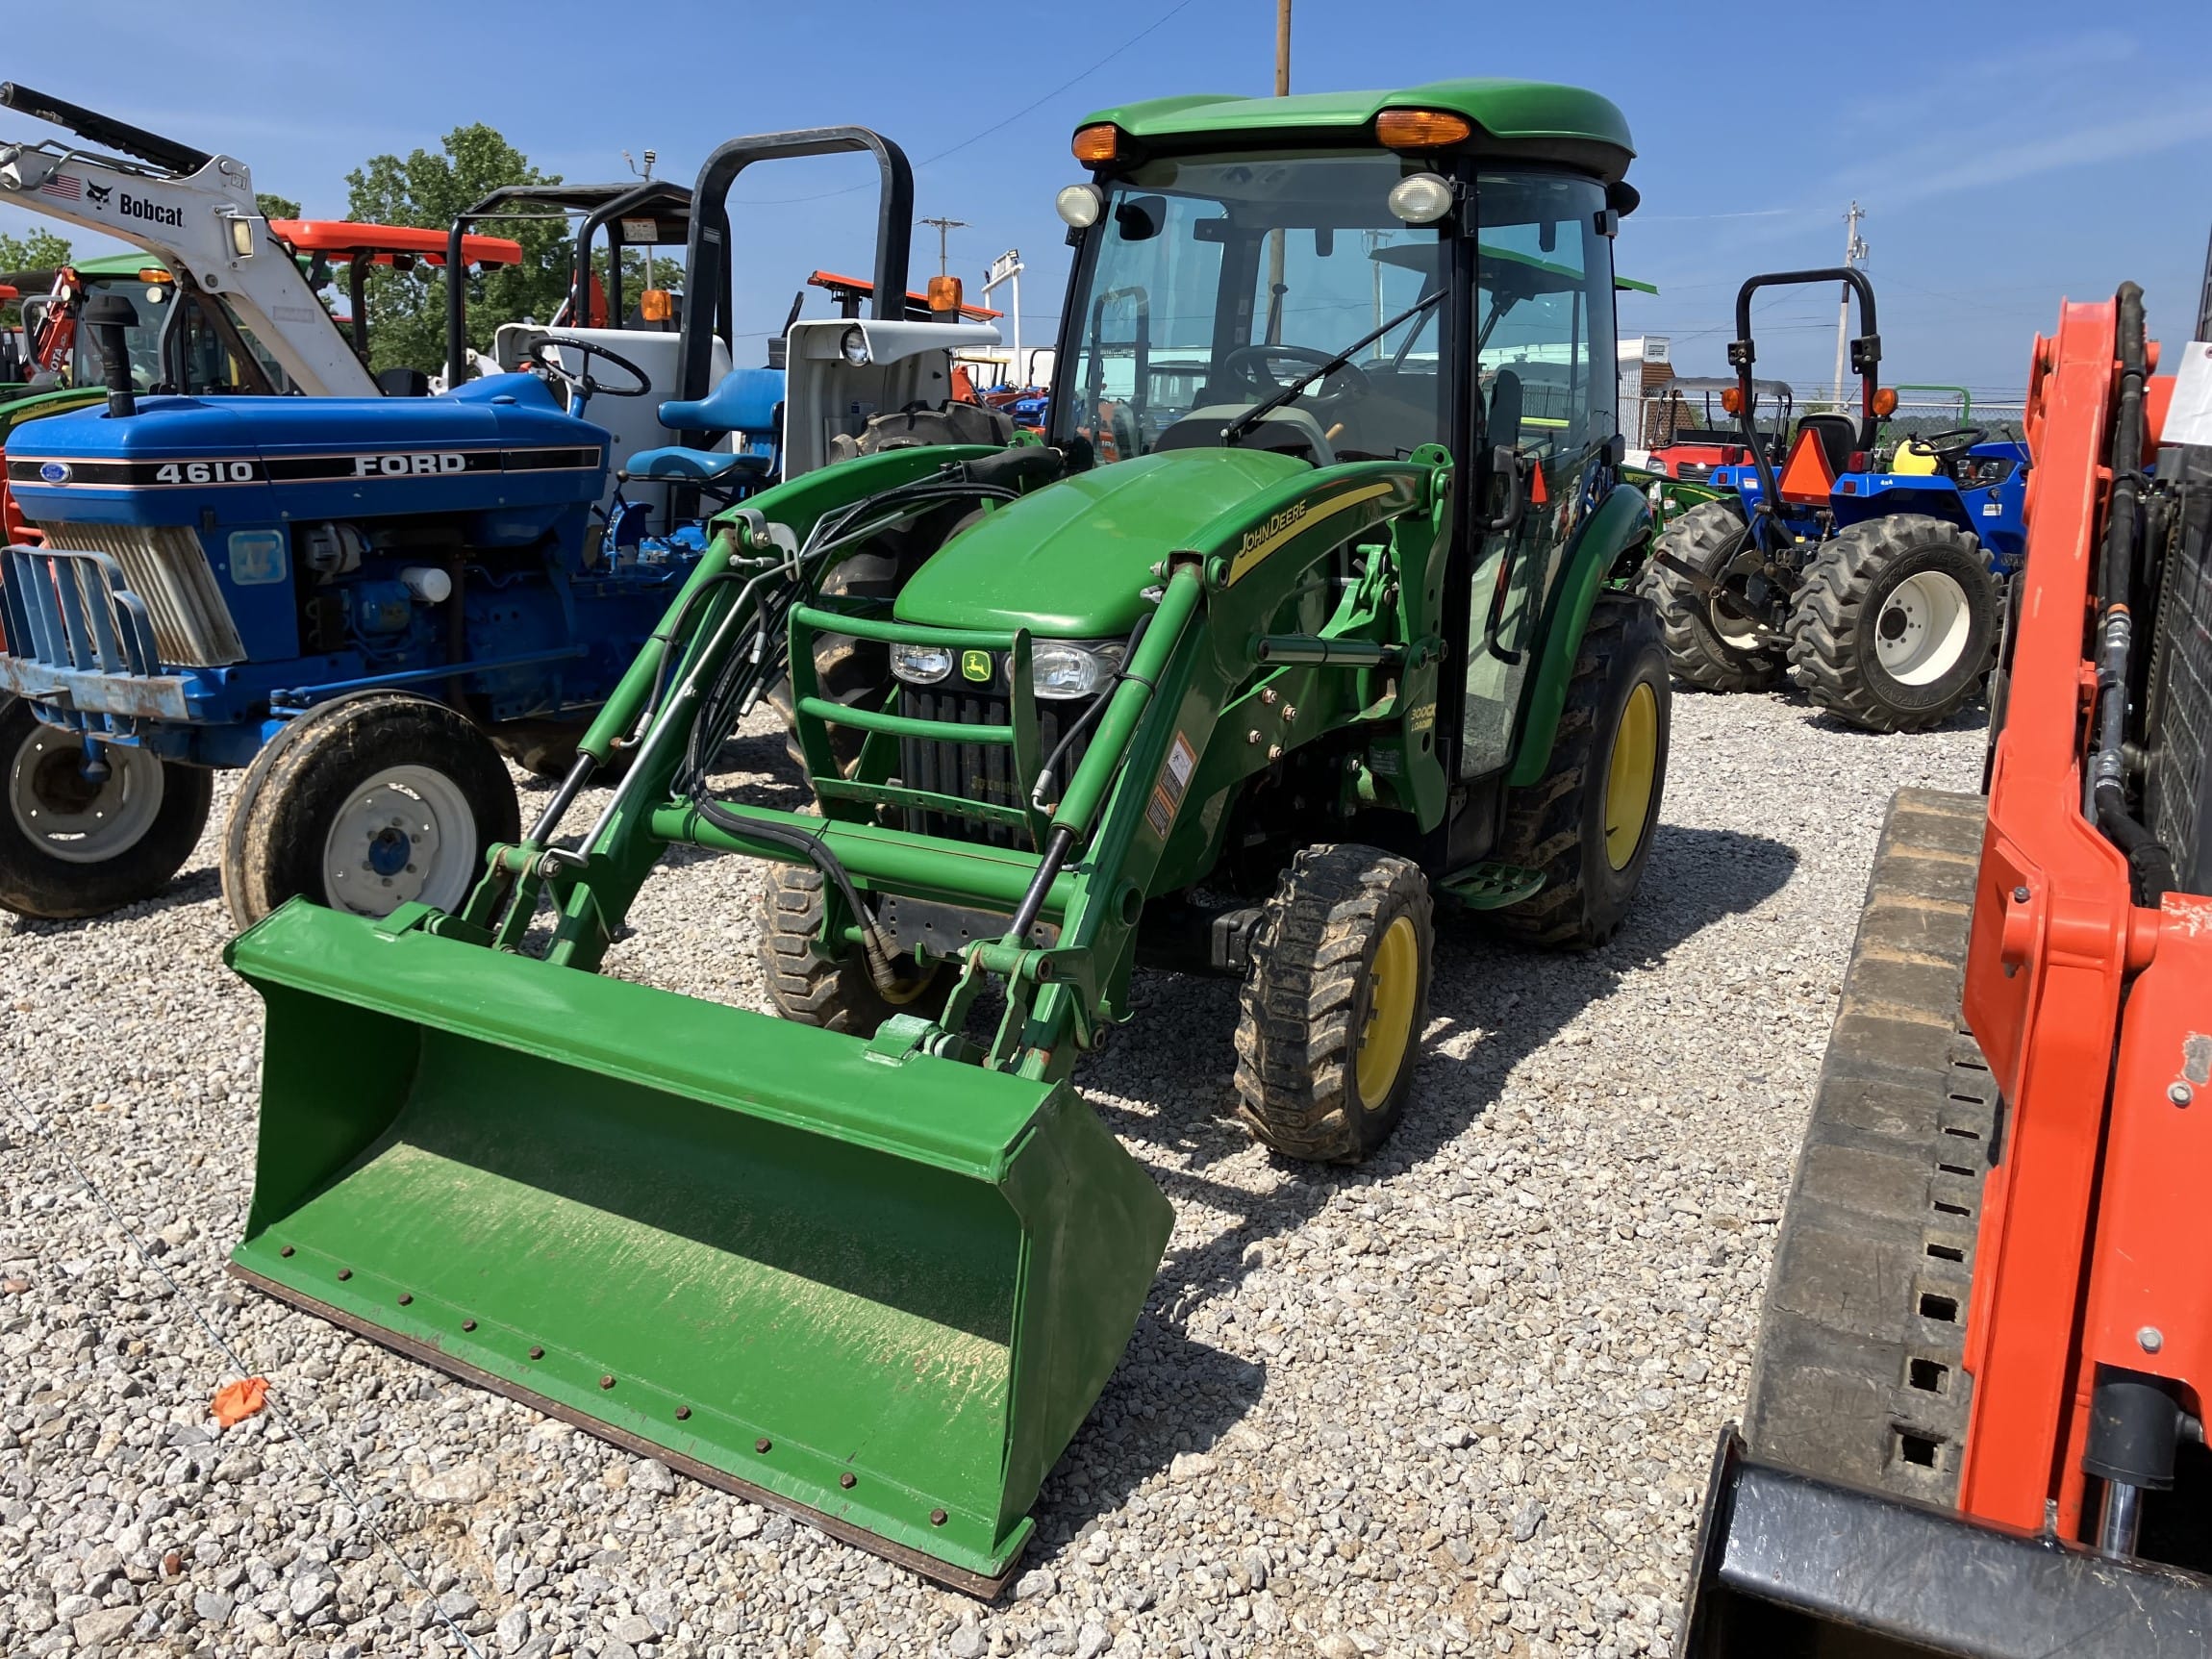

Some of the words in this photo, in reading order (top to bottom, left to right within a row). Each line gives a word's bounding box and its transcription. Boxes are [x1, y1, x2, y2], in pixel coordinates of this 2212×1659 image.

[120, 193, 183, 227] Bobcat
[156, 462, 254, 484] 4610
[354, 453, 466, 477] FORD
[1238, 520, 1271, 558] JOHN
[1269, 499, 1308, 537] DEERE
